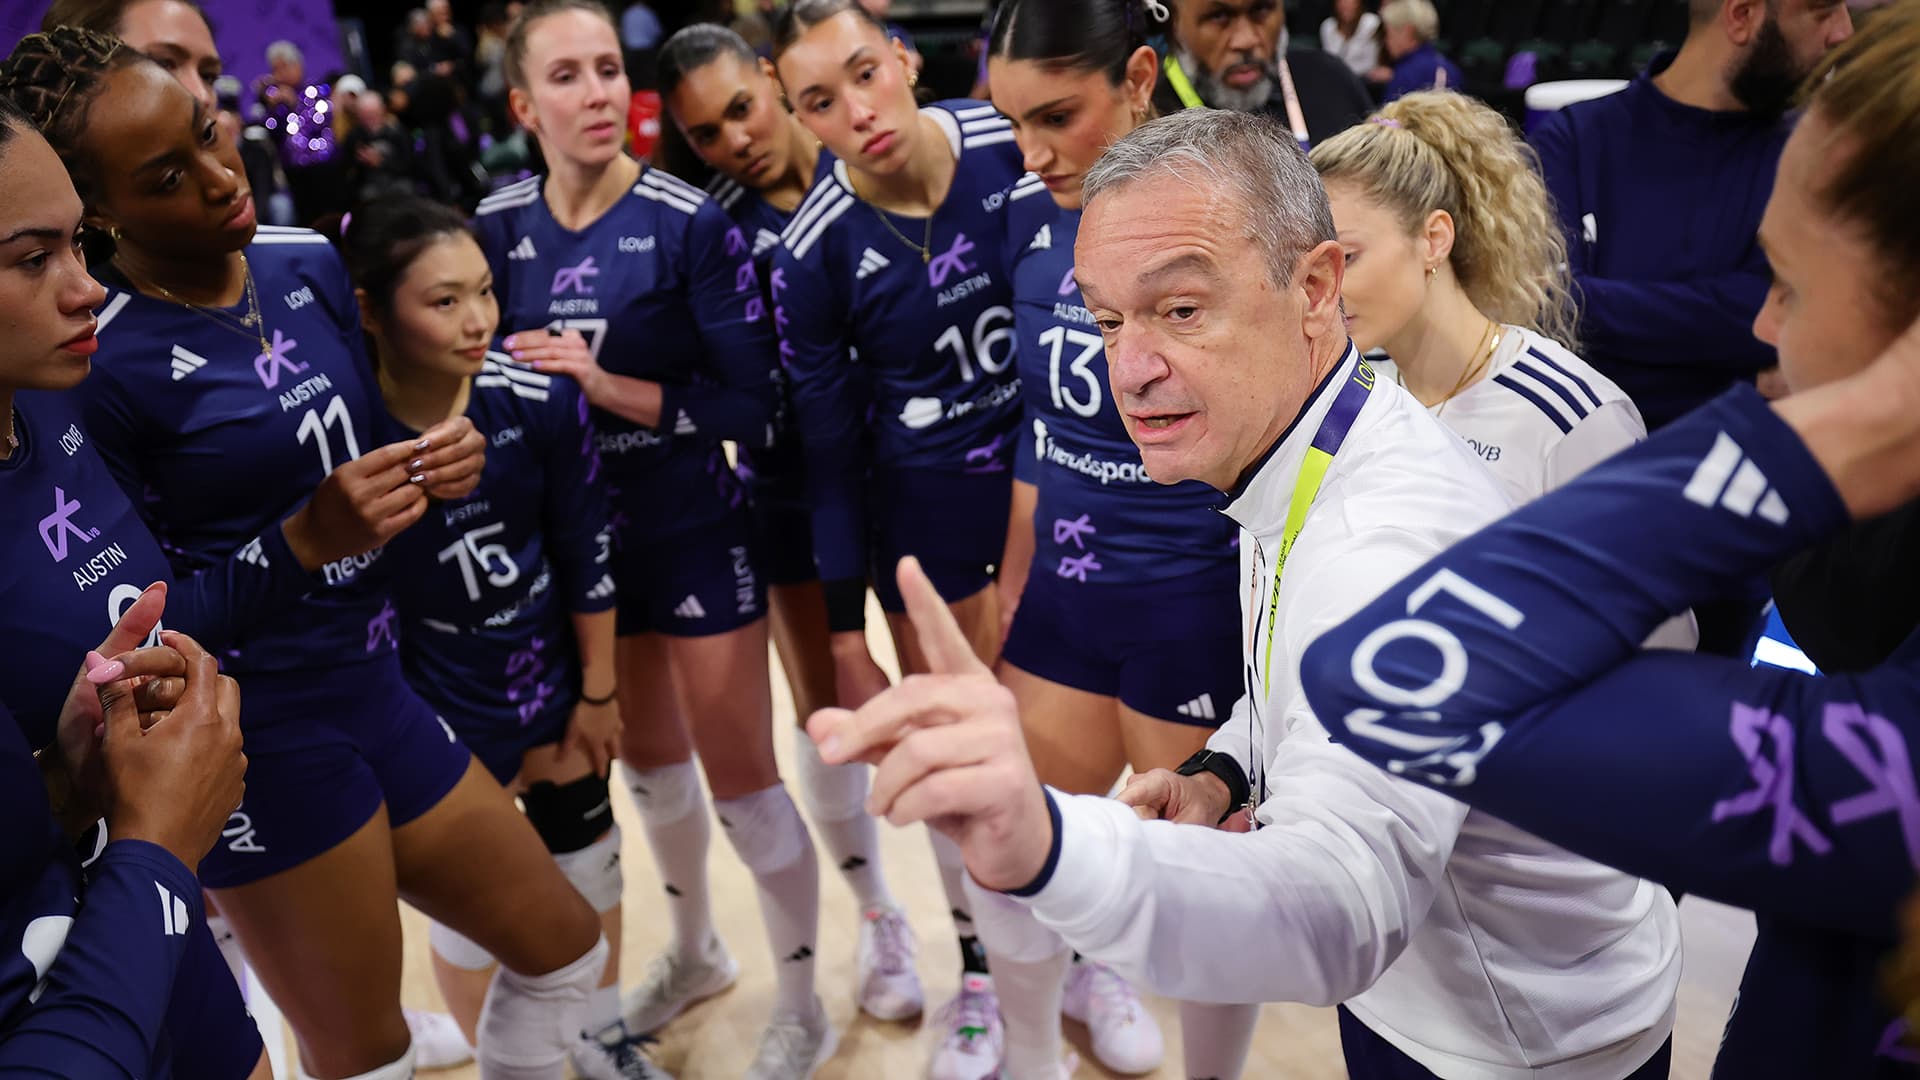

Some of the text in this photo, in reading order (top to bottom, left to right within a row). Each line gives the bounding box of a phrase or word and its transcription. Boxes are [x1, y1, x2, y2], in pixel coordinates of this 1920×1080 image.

[548, 298, 599, 315] AUSTIN
[936, 272, 992, 307] AUSTIN
[544, 318, 608, 361] 7
[934, 305, 1017, 382] 16
[278, 372, 332, 412] AUSTIN
[1039, 325, 1103, 417] 13
[59, 424, 84, 457] LOVB
[296, 394, 361, 478] 11
[1461, 435, 1502, 462] OVB
[1046, 436, 1152, 485] headspac
[72, 542, 128, 591] AUSTIN
[438, 522, 520, 600] 15
